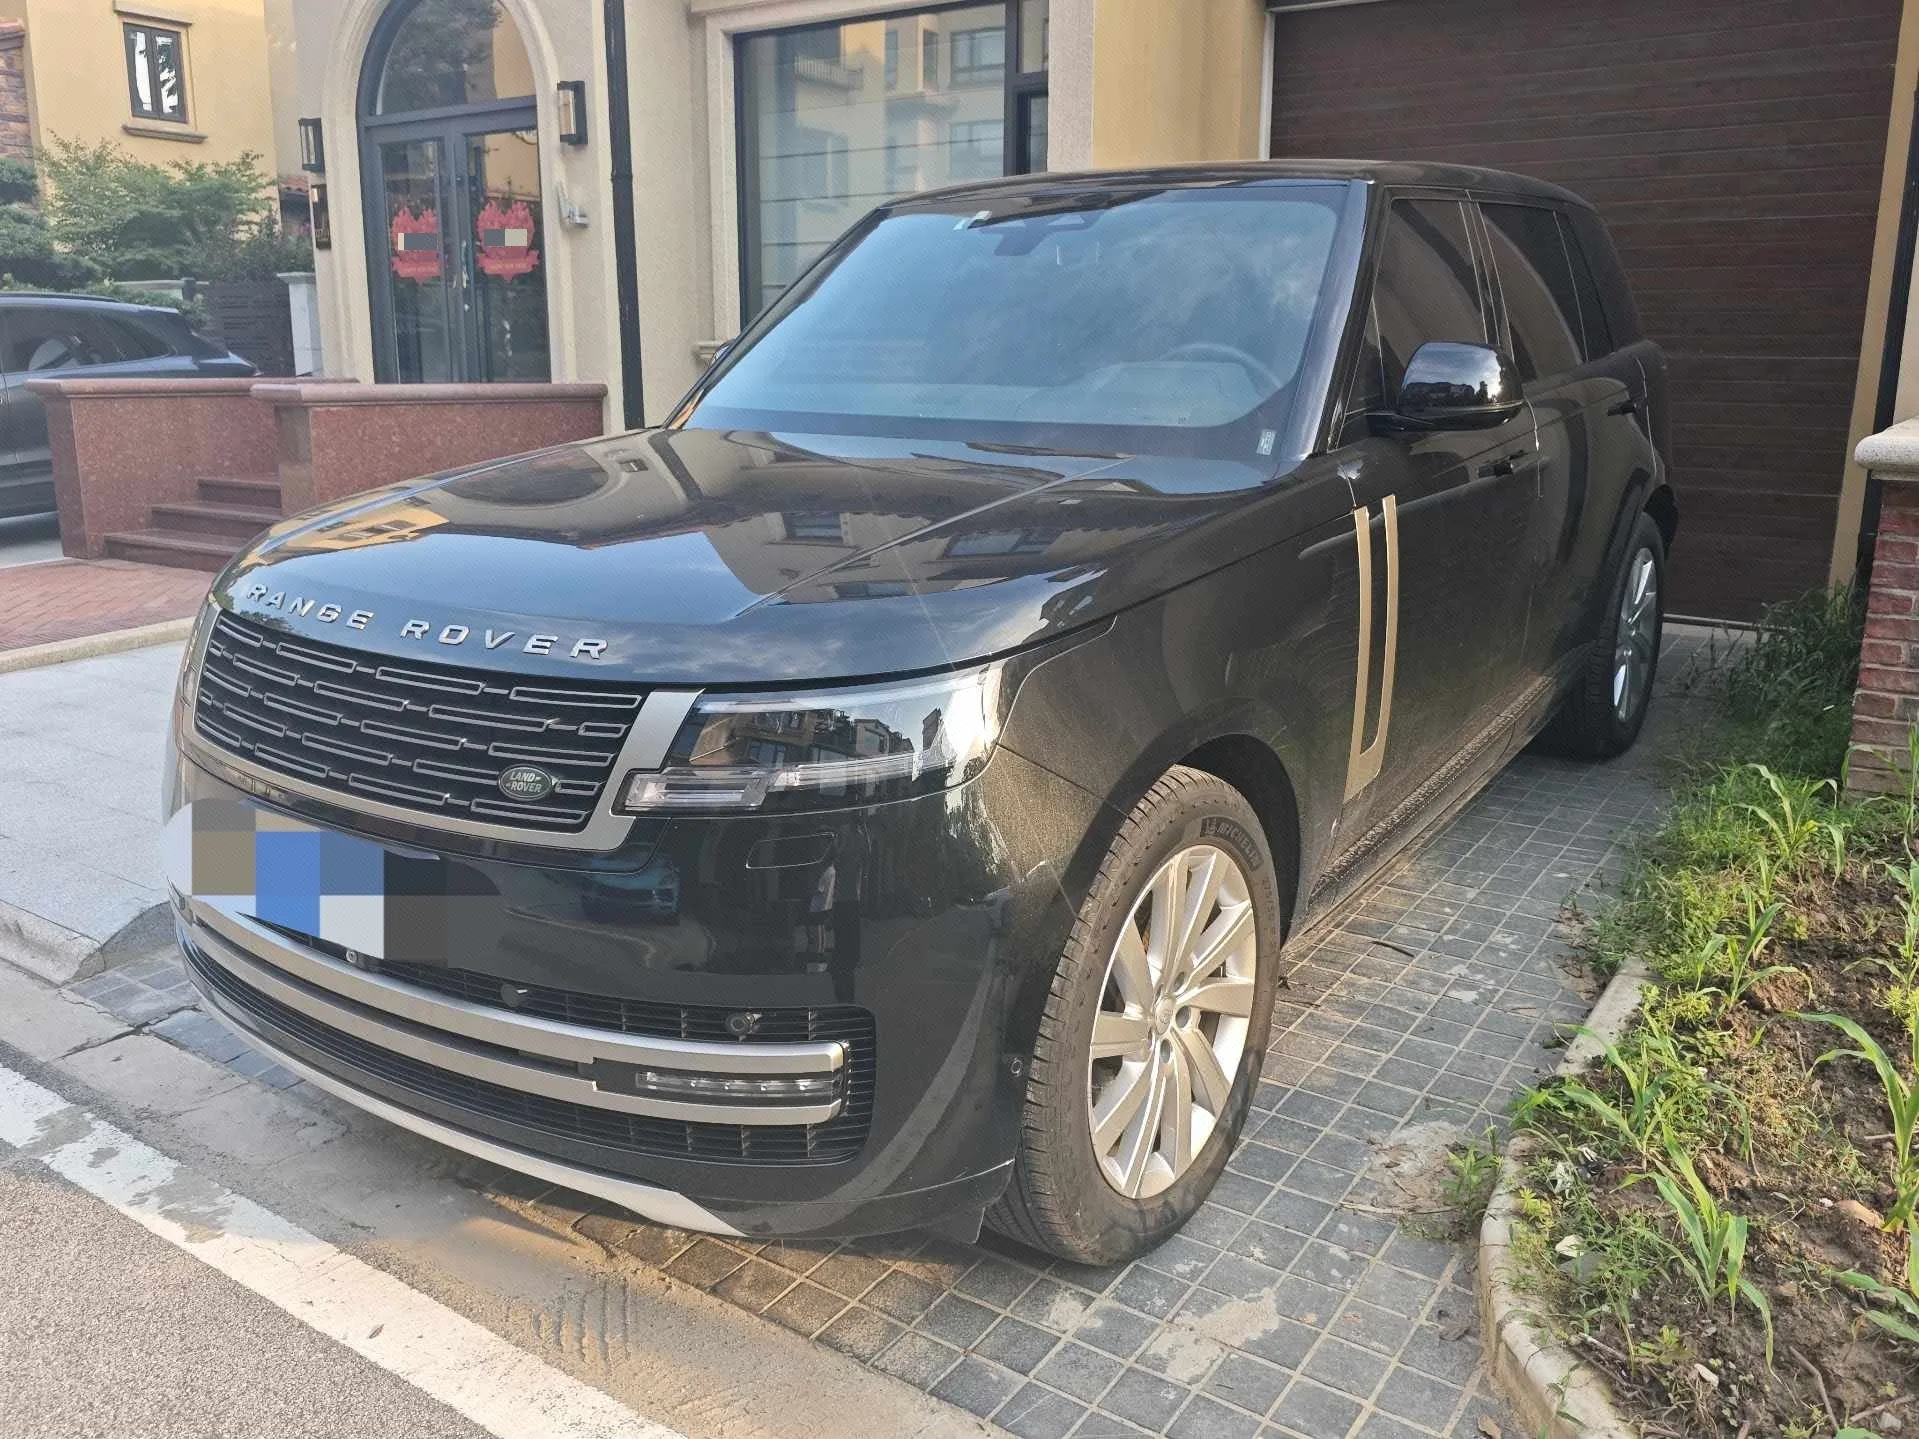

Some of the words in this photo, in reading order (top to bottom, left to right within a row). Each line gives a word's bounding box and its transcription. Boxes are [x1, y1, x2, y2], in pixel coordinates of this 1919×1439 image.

[246, 583, 374, 630] RANGE
[400, 619, 608, 660] ROVER
[510, 781, 542, 793] ROVER
